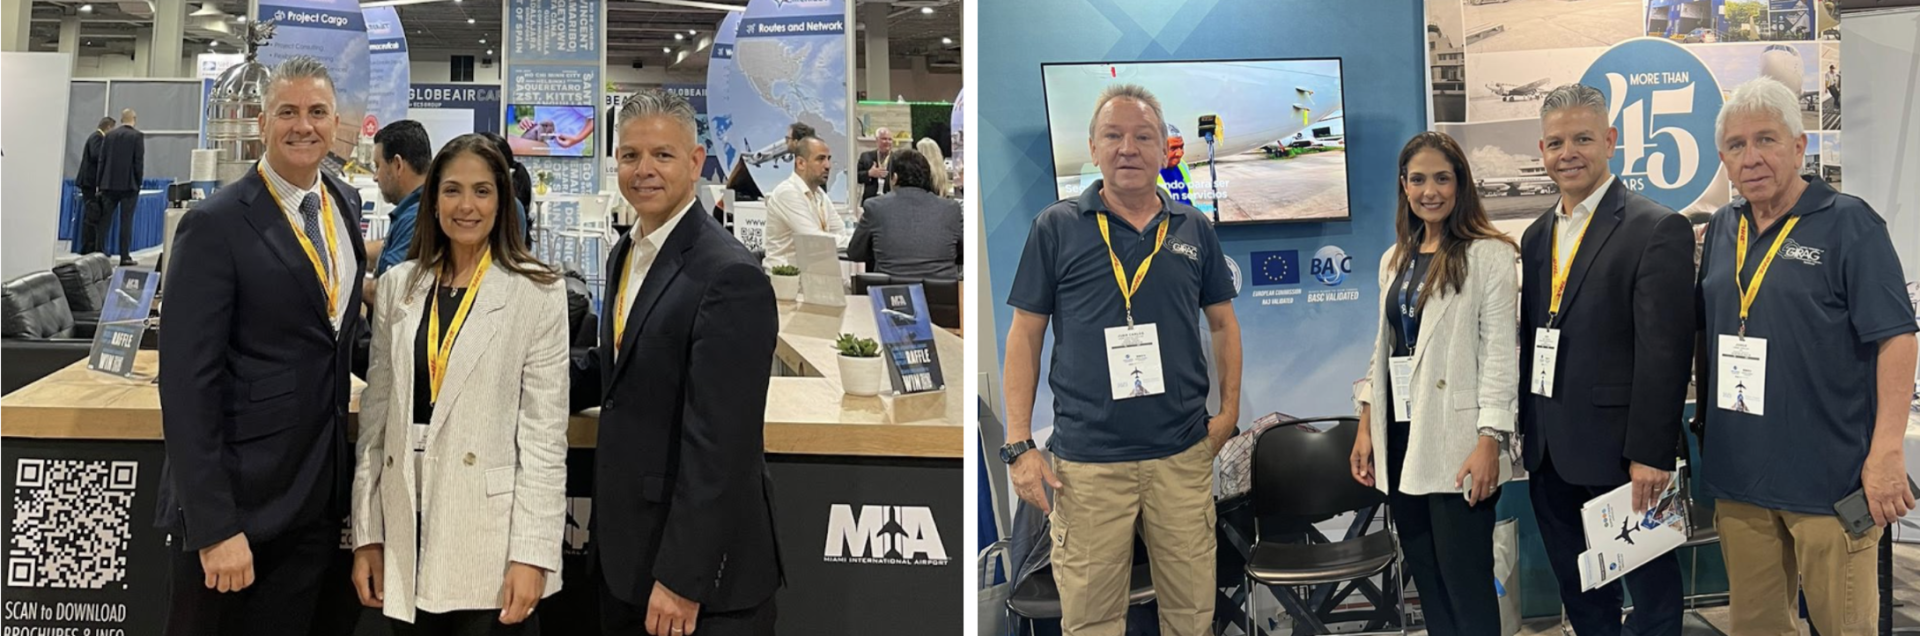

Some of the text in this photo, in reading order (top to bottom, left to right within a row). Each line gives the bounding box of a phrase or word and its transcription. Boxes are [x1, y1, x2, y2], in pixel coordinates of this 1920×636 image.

[287, 11, 348, 27] Project Cargo
[515, 7, 523, 21] OF
[568, 0, 577, 50] MARIBO
[758, 20, 843, 33] Routes and Network
[515, 23, 523, 54] SPAIN
[369, 42, 400, 51] maceuticals
[1629, 71, 1689, 85] MORE THAN
[545, 92, 582, 102] KITTS
[1188, 180, 1211, 191] para
[1214, 180, 1229, 188] ser
[1622, 178, 1645, 191] ARS
[1181, 189, 1228, 200] servicios
[1307, 291, 1360, 303] BASC VALIDATED
[111, 331, 133, 348] RAFFLE
[904, 348, 931, 364] RAFFLE
[824, 503, 948, 560] MIA
[848, 557, 912, 565] INTERNATIONAL
[5, 601, 126, 623] SCAN to DOWNLOAD
